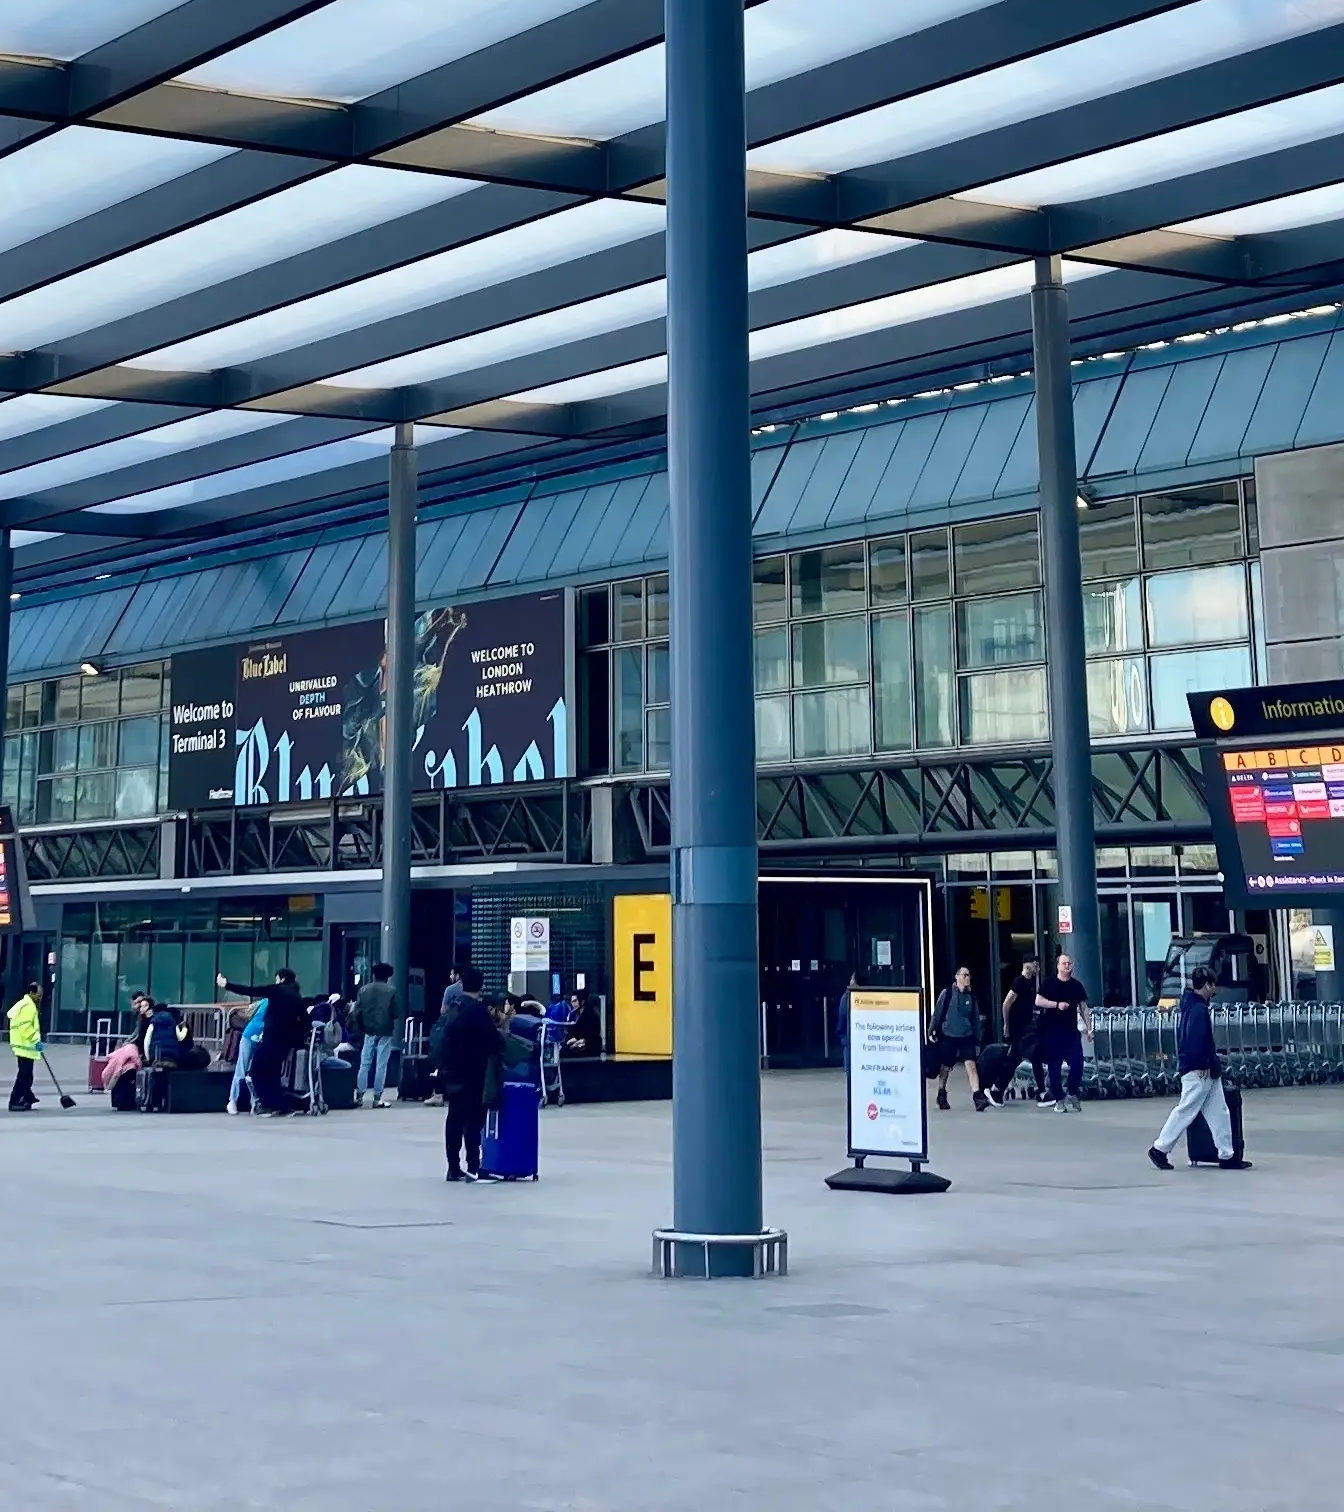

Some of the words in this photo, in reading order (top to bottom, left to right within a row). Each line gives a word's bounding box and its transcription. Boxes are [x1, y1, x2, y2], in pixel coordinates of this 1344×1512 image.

[470, 643, 518, 664] WELCOME
[520, 642, 535, 656] TO
[241, 656, 263, 682] Blue
[263, 653, 287, 678] Label
[482, 662, 524, 681] LONDON
[289, 676, 338, 693] UNRIVALLED
[475, 679, 533, 698] HEATHROW
[299, 692, 326, 705] DEPTH
[173, 702, 220, 725] Welcome
[221, 700, 234, 719] to
[292, 708, 304, 720] OF
[305, 704, 341, 719] FLAVOUR
[172, 729, 217, 754] Terminal
[218, 728, 226, 749] 3
[1237, 754, 1246, 768] A
[1267, 752, 1276, 766] B
[1299, 750, 1308, 764] C
[1331, 748, 1342, 762] D
[633, 933, 656, 1002] E
